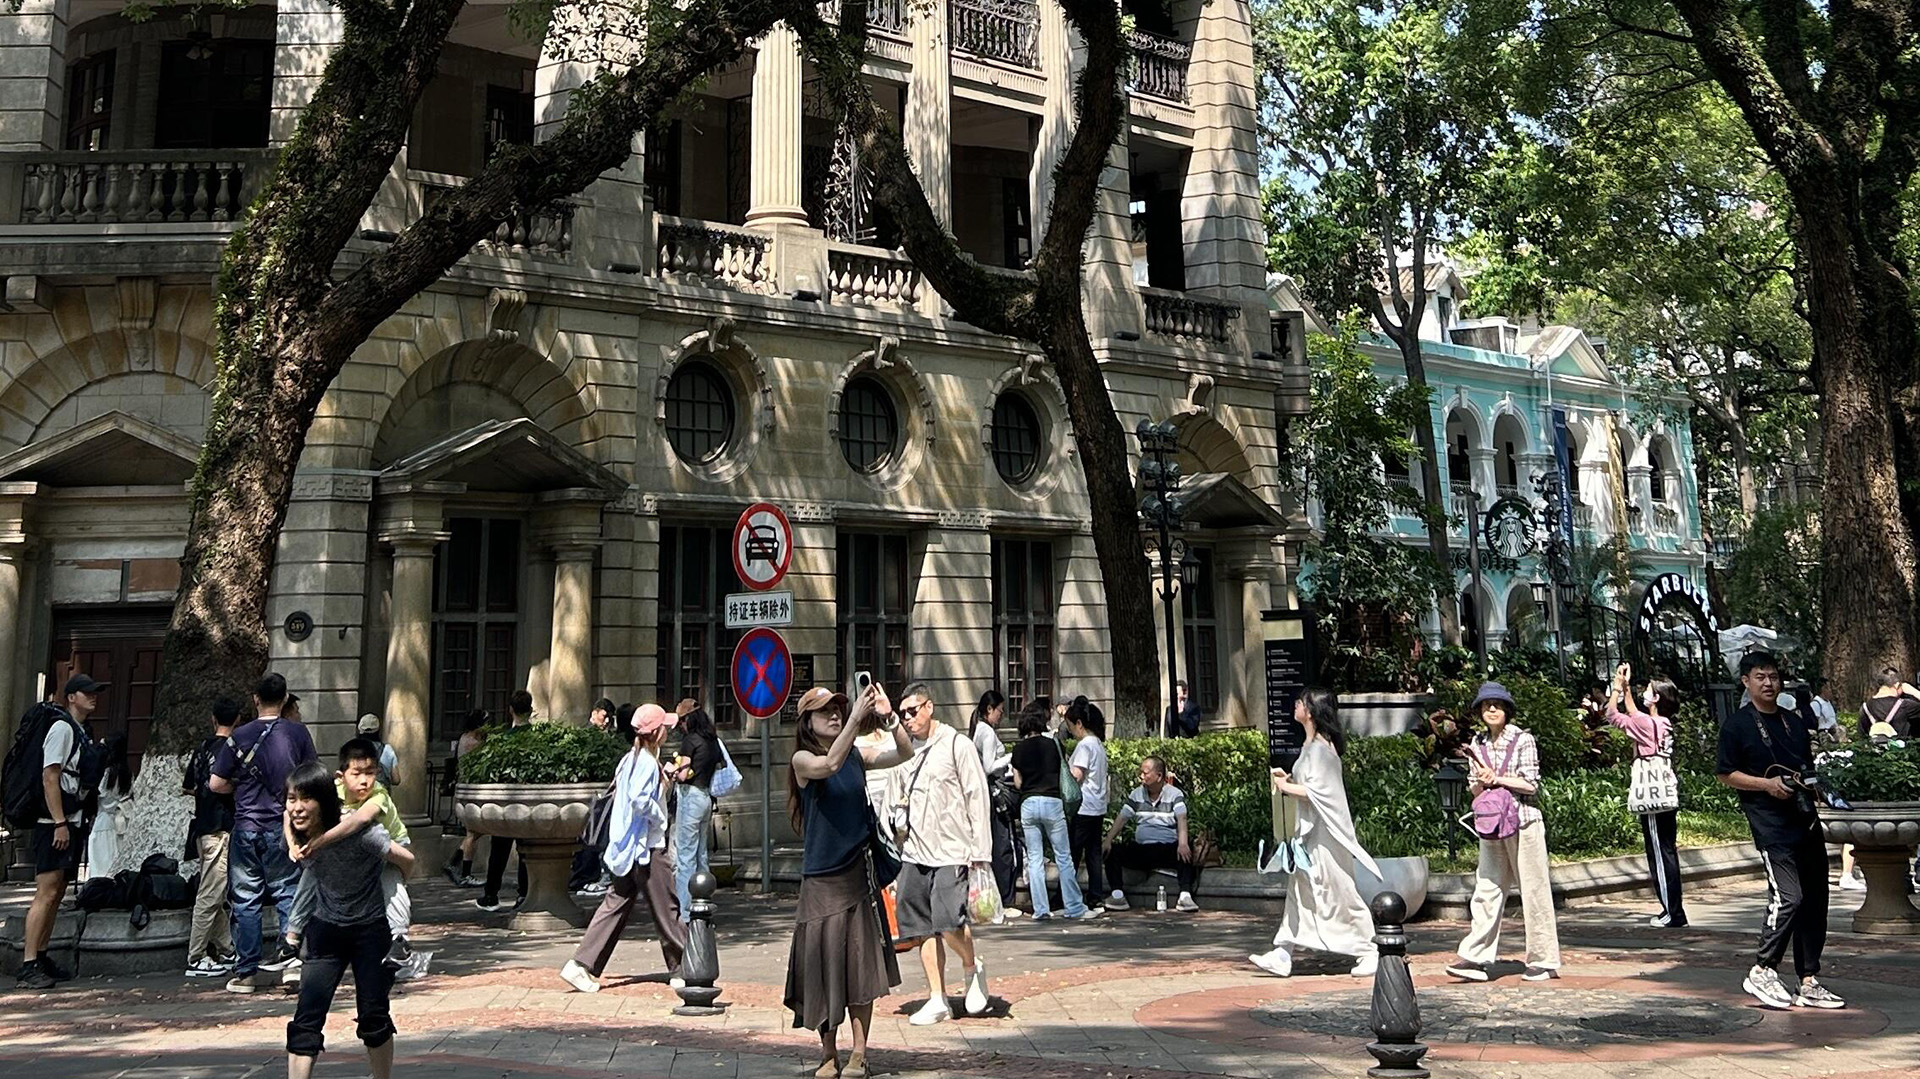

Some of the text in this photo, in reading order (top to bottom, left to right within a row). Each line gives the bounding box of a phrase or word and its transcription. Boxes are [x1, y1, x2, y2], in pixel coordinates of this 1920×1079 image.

[729, 598, 789, 622] 持证车辆除外
[1641, 574, 1718, 633] STARBUCKS
